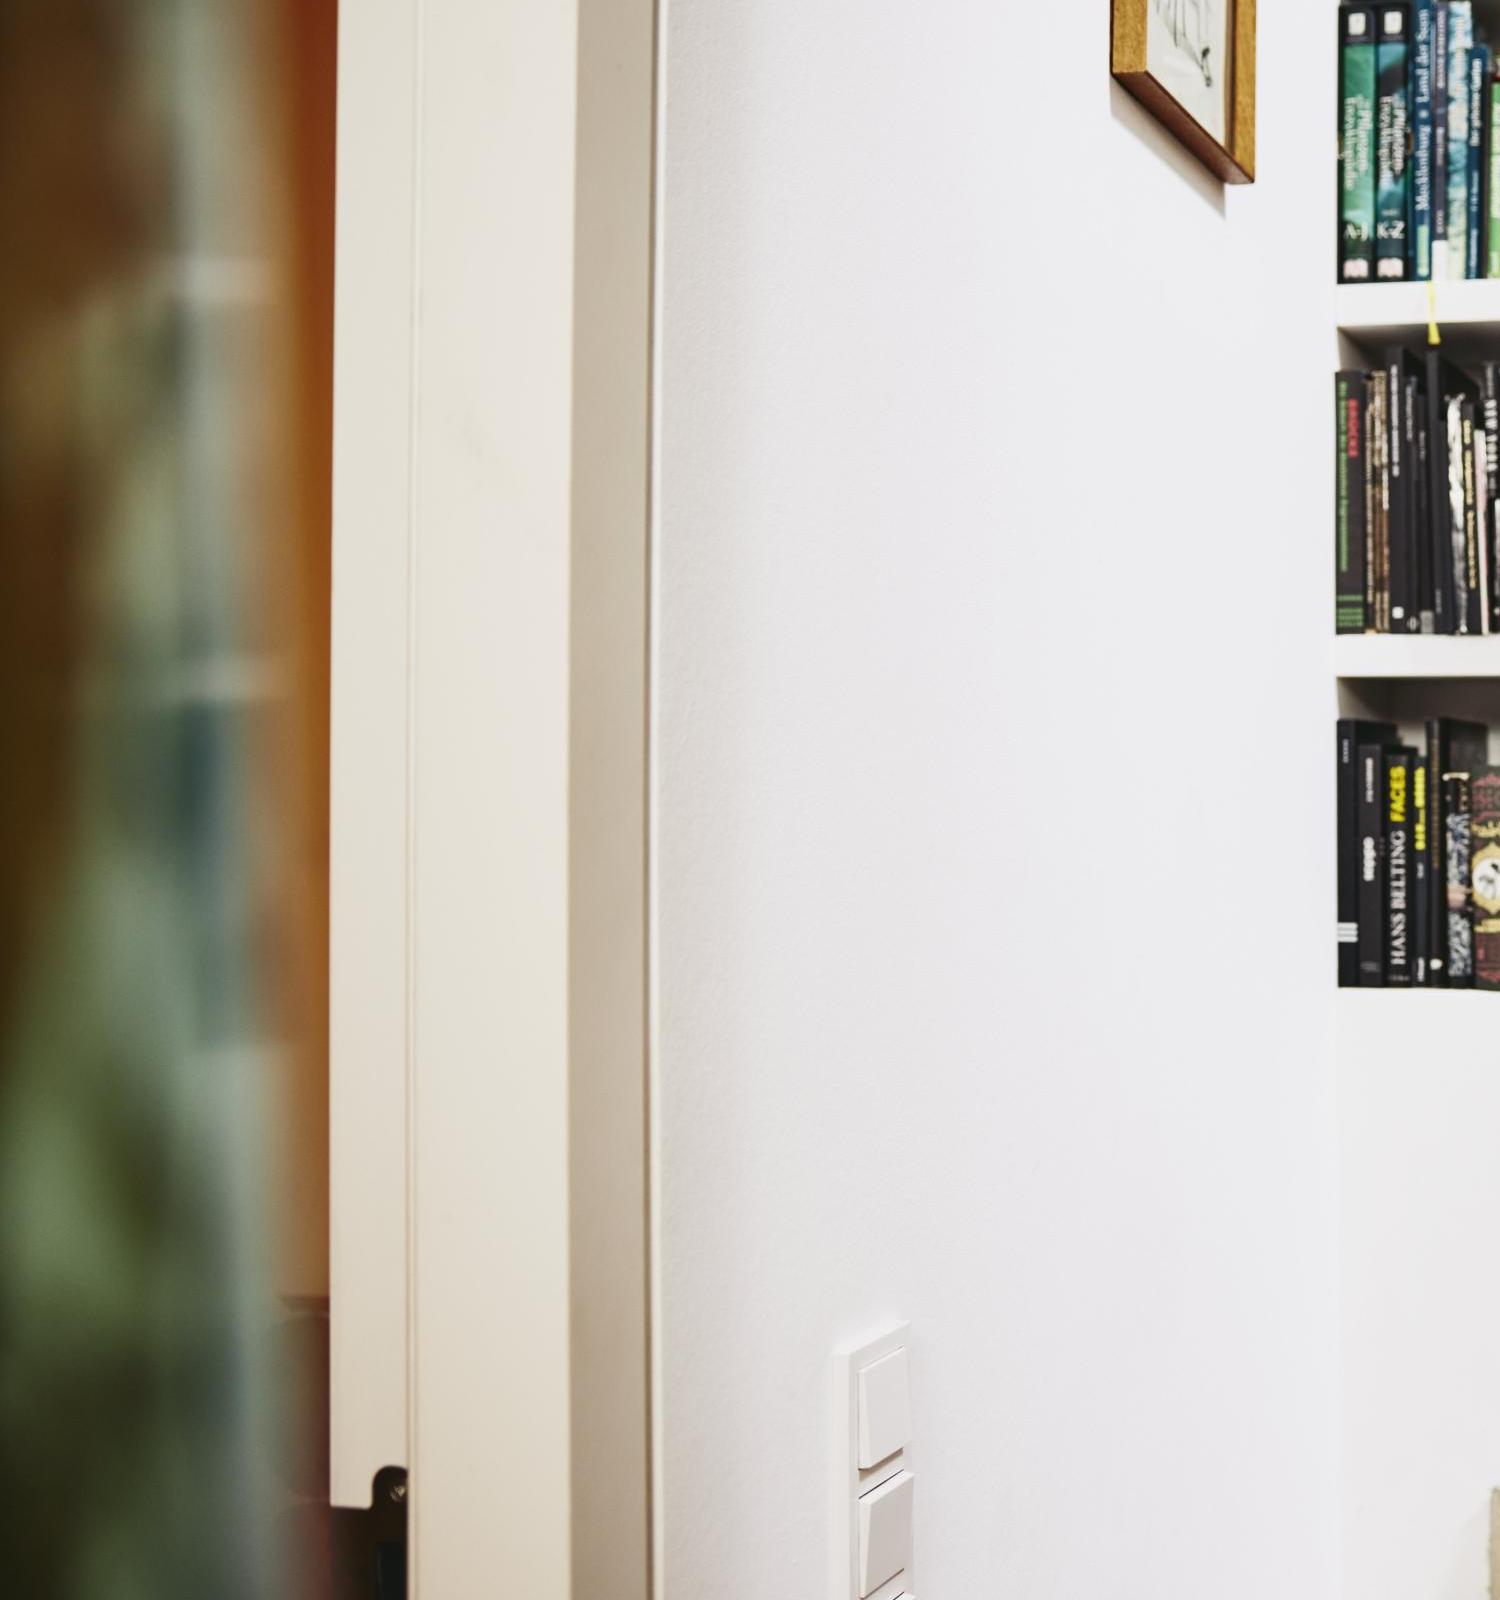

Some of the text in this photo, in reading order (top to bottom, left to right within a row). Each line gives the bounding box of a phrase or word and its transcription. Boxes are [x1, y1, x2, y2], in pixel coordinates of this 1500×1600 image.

[1389, 765, 1407, 965] HANS BELTING FACES
